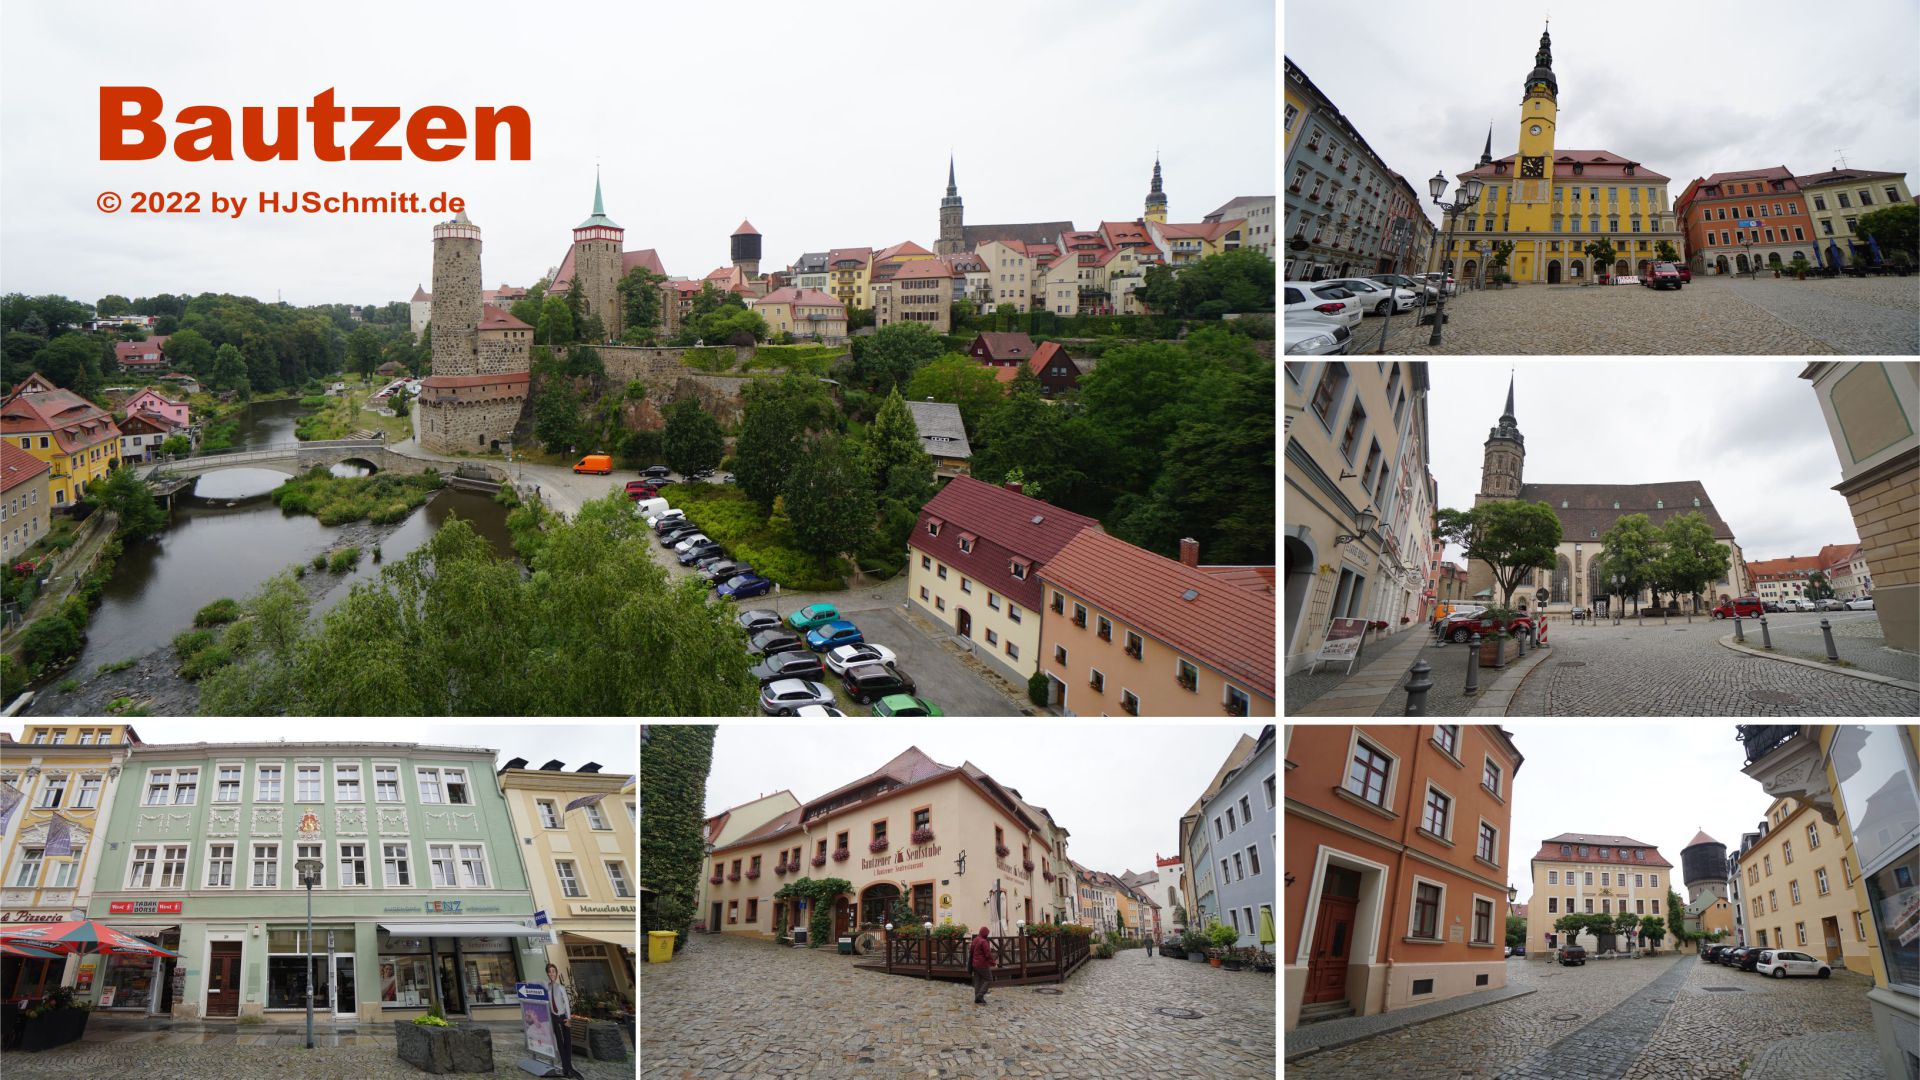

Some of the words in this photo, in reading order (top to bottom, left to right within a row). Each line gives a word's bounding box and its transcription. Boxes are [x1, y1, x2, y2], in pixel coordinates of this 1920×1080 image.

[906, 843, 942, 861] Senfstube
[425, 900, 463, 913] LENZ
[580, 904, 620, 913] Manuelas
[0, 912, 10, 922] &
[13, 910, 63, 922] Pizzeria
